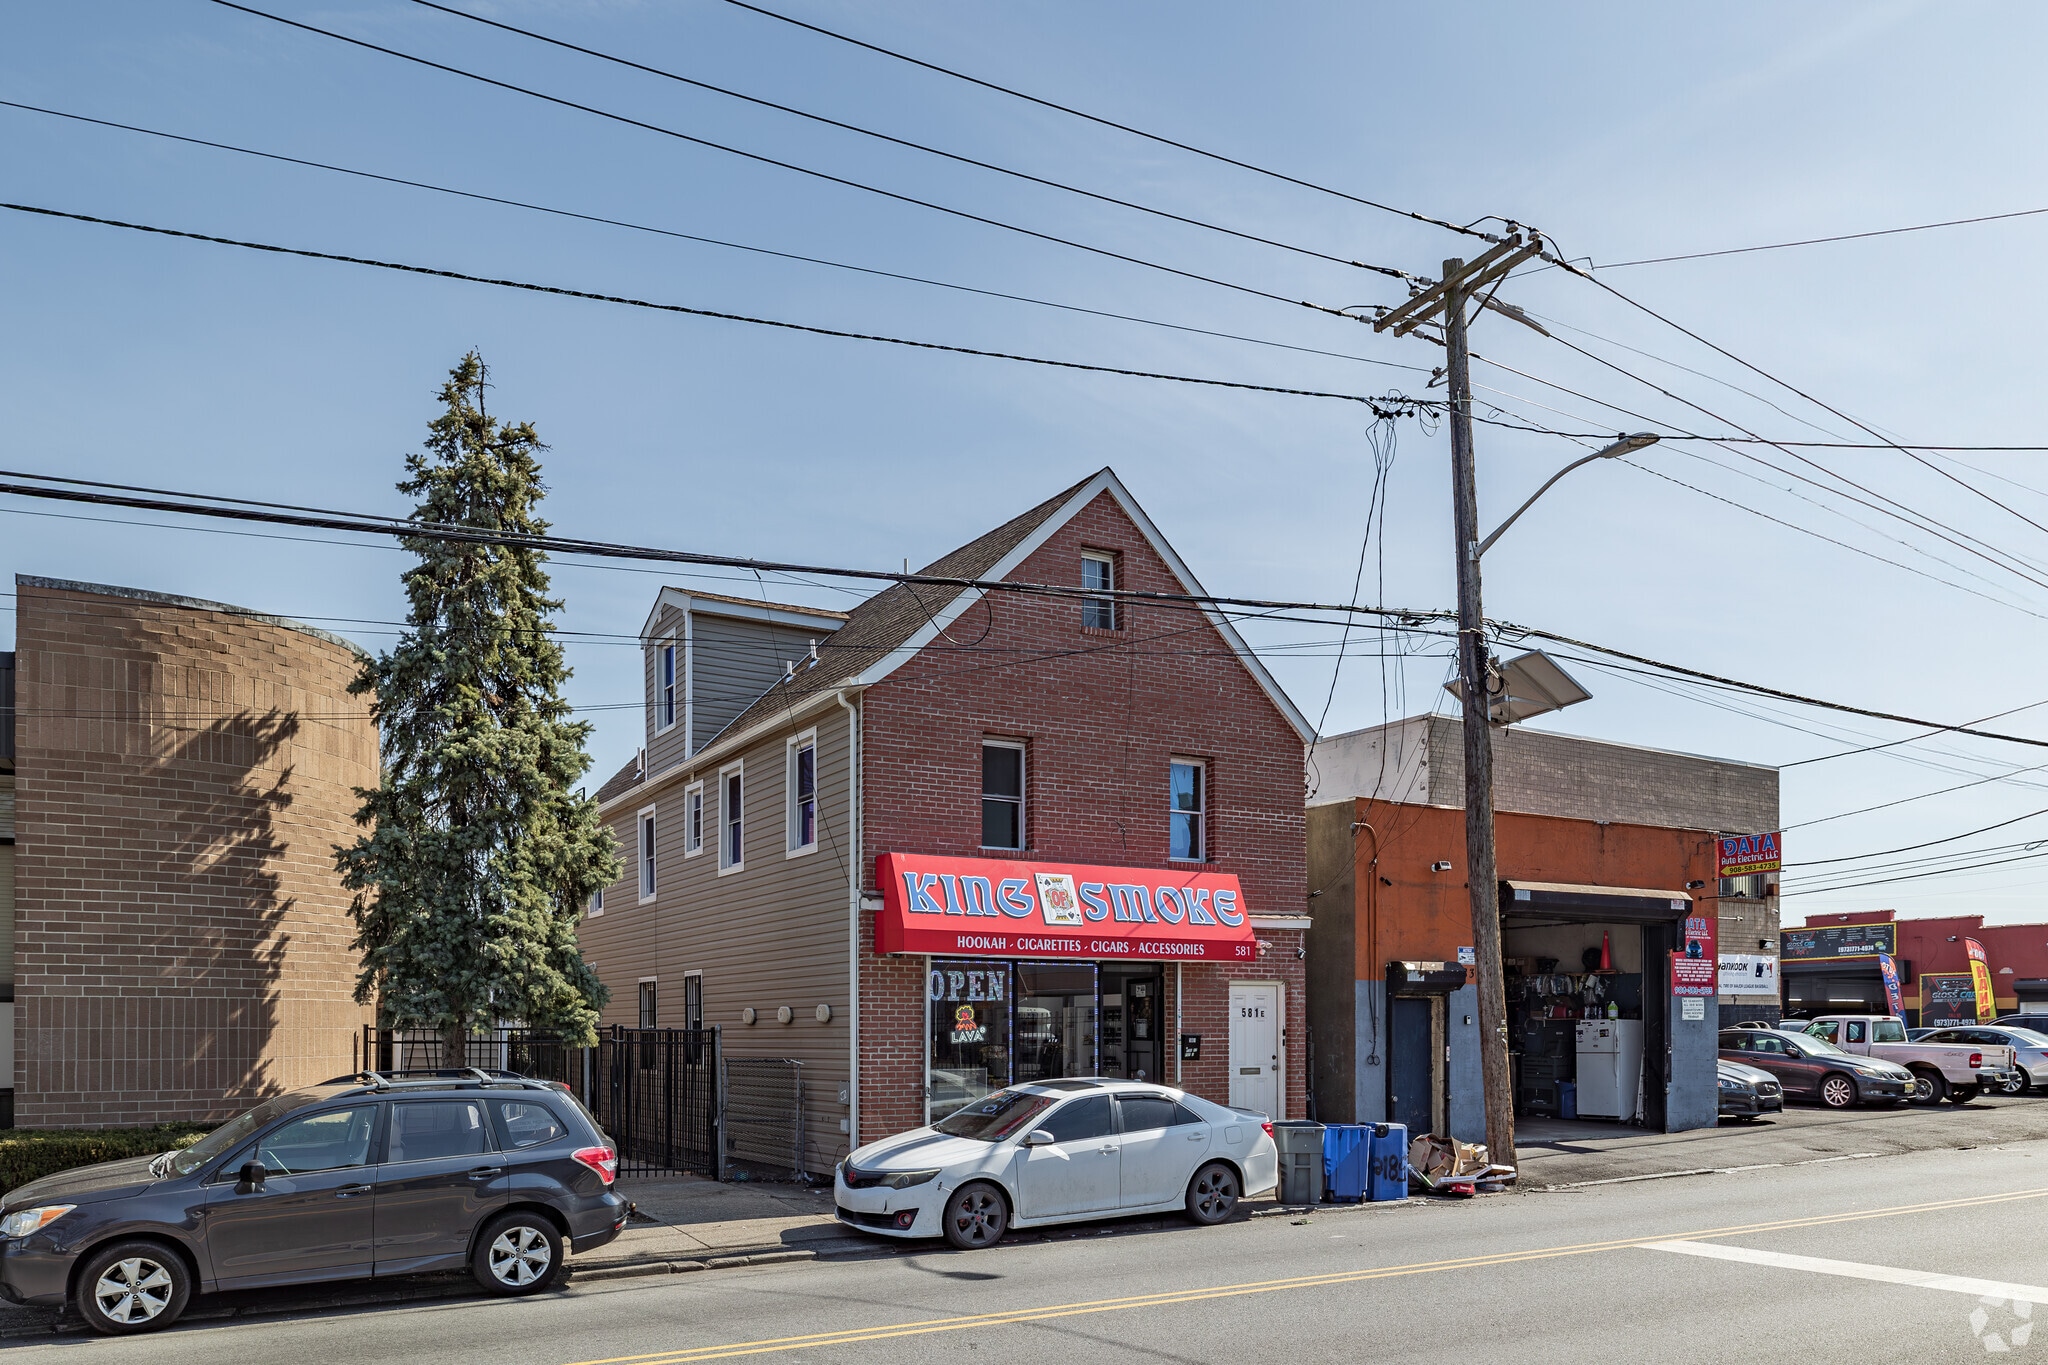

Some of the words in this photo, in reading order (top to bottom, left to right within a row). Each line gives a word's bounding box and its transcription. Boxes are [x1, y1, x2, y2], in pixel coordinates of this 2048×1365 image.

[1723, 833, 1776, 856] DATA
[1721, 857, 1737, 865] Auto
[1737, 852, 1764, 863] Electric
[1765, 850, 1779, 860] LLC
[1729, 862, 1776, 874] 908-583-4735
[902, 872, 1035, 919] KING
[1051, 890, 1067, 908] OF
[1078, 882, 1244, 927] SMOKE
[957, 935, 1007, 950] HOOKAH
[1016, 938, 1081, 952] CIGARETTES
[1090, 940, 1129, 953] CIGARS
[1138, 942, 1205, 956] ACCESSORIES
[1235, 945, 1250, 956] 581
[930, 970, 1005, 1002] OPEN
[1931, 990, 1958, 999] GLOSS
[1241, 1007, 1265, 1018] 581E
[1933, 1018, 1976, 1027] (973)771-4974
